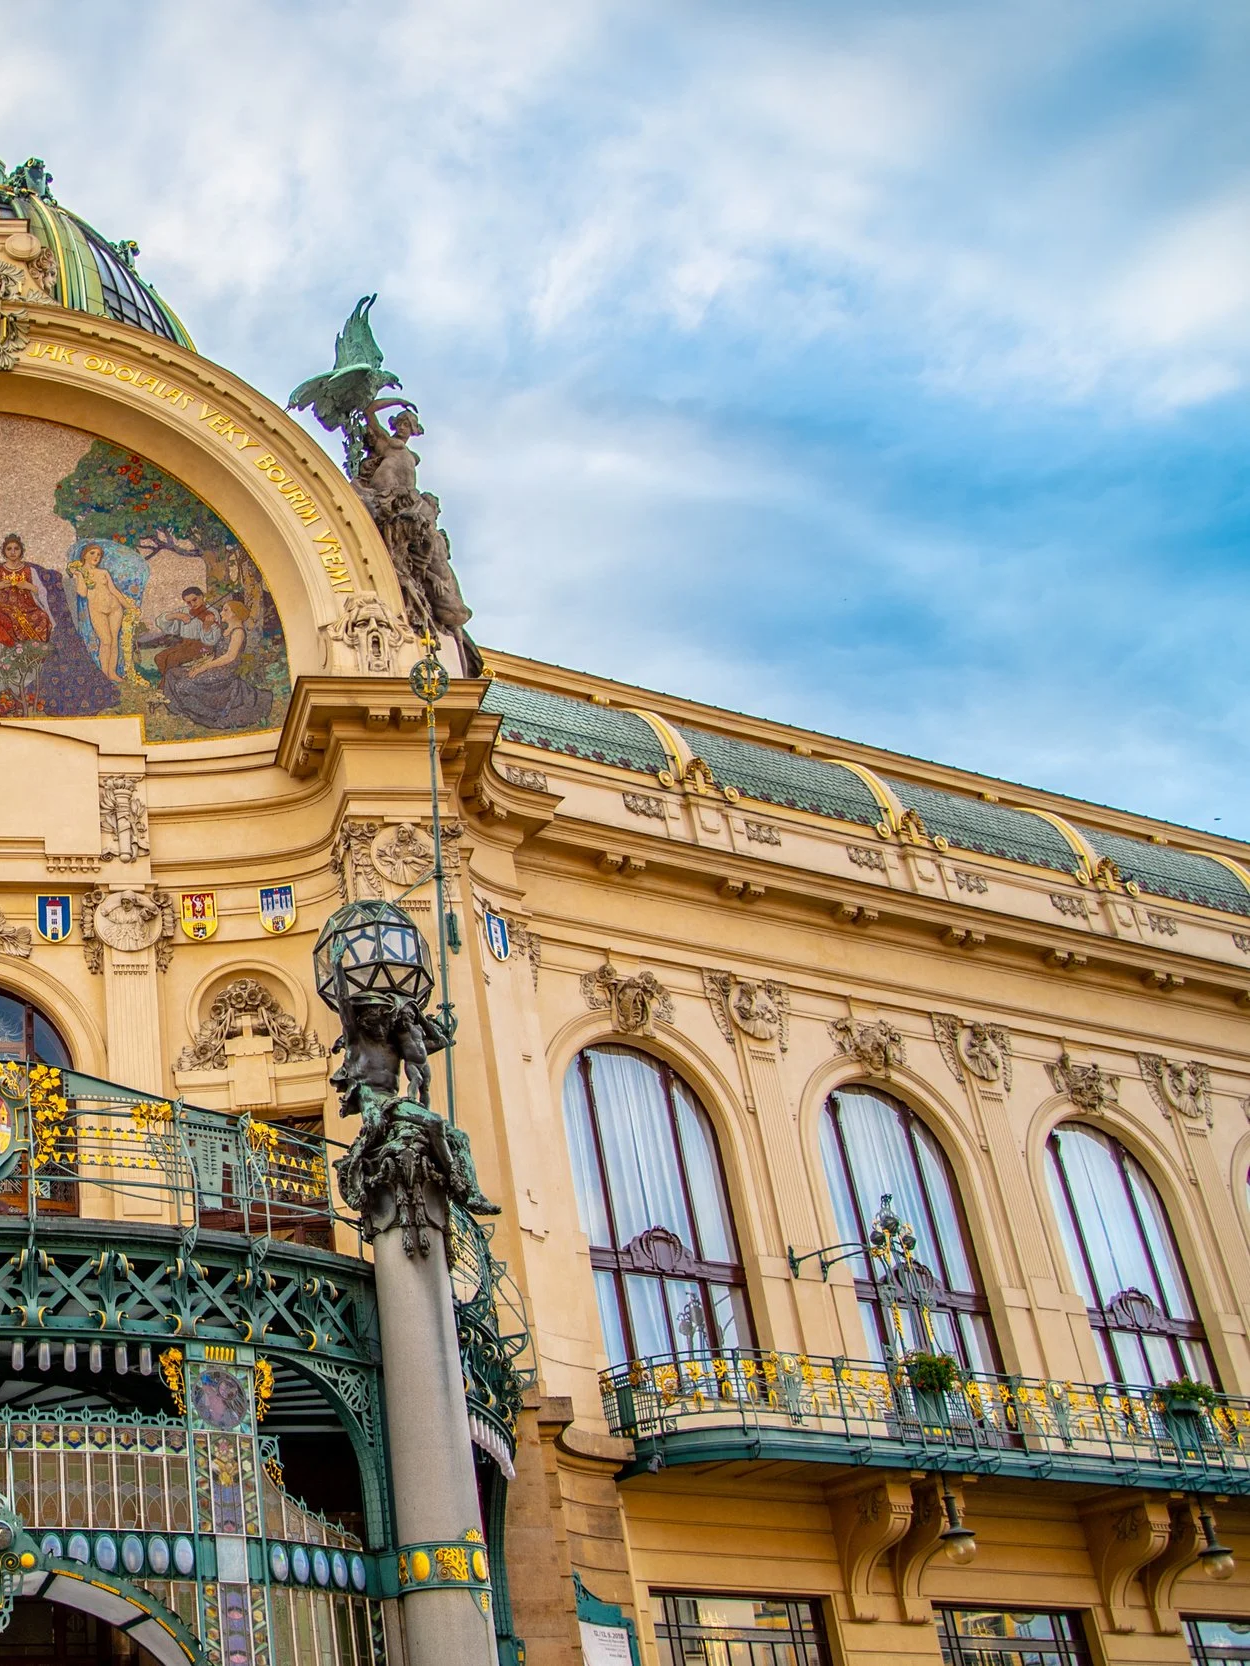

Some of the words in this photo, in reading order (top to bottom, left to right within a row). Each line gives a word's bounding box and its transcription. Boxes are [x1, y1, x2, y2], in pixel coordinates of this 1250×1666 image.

[26, 342, 78, 365] JAK
[83, 355, 194, 410] ODOLALAS
[199, 402, 260, 451] VĚKY
[253, 453, 321, 527] BOUŘÍM
[312, 529, 354, 593] VŠEM!
